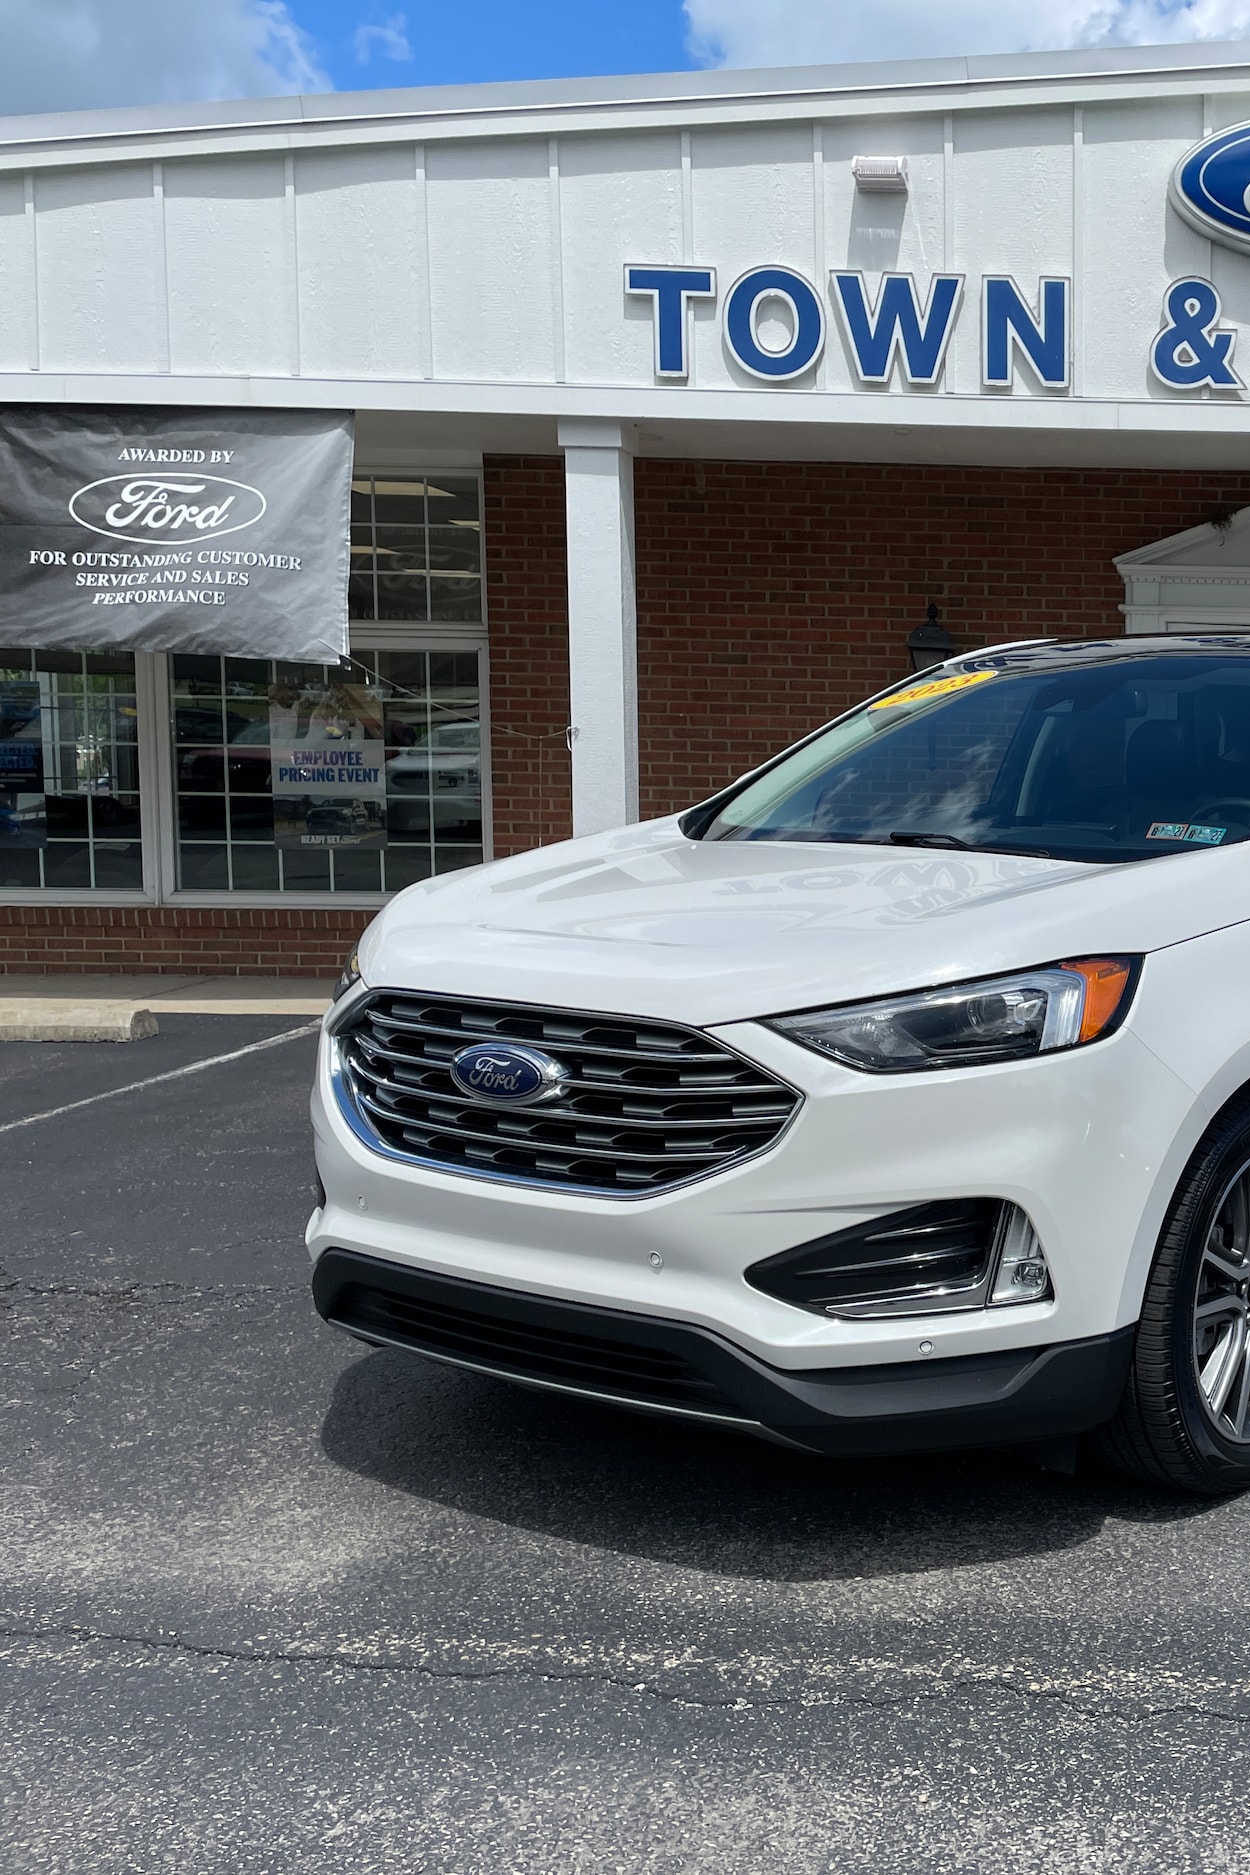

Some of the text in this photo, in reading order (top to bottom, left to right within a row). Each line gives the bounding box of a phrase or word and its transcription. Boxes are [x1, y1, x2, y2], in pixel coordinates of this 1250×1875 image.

[624, 264, 1071, 387] TOWN
[1149, 276, 1247, 391] &
[118, 448, 234, 464] AWARDED BY
[105, 480, 235, 529] Ford
[29, 550, 301, 571] FOR OUTSTANDING CUSTOMER
[76, 570, 249, 587] SERVICE AND SALES
[92, 590, 226, 606] PERFORMANCE
[293, 751, 363, 766] EMPLOYEE
[279, 767, 380, 782] PRICING EVENT
[469, 1056, 522, 1091] Ford
